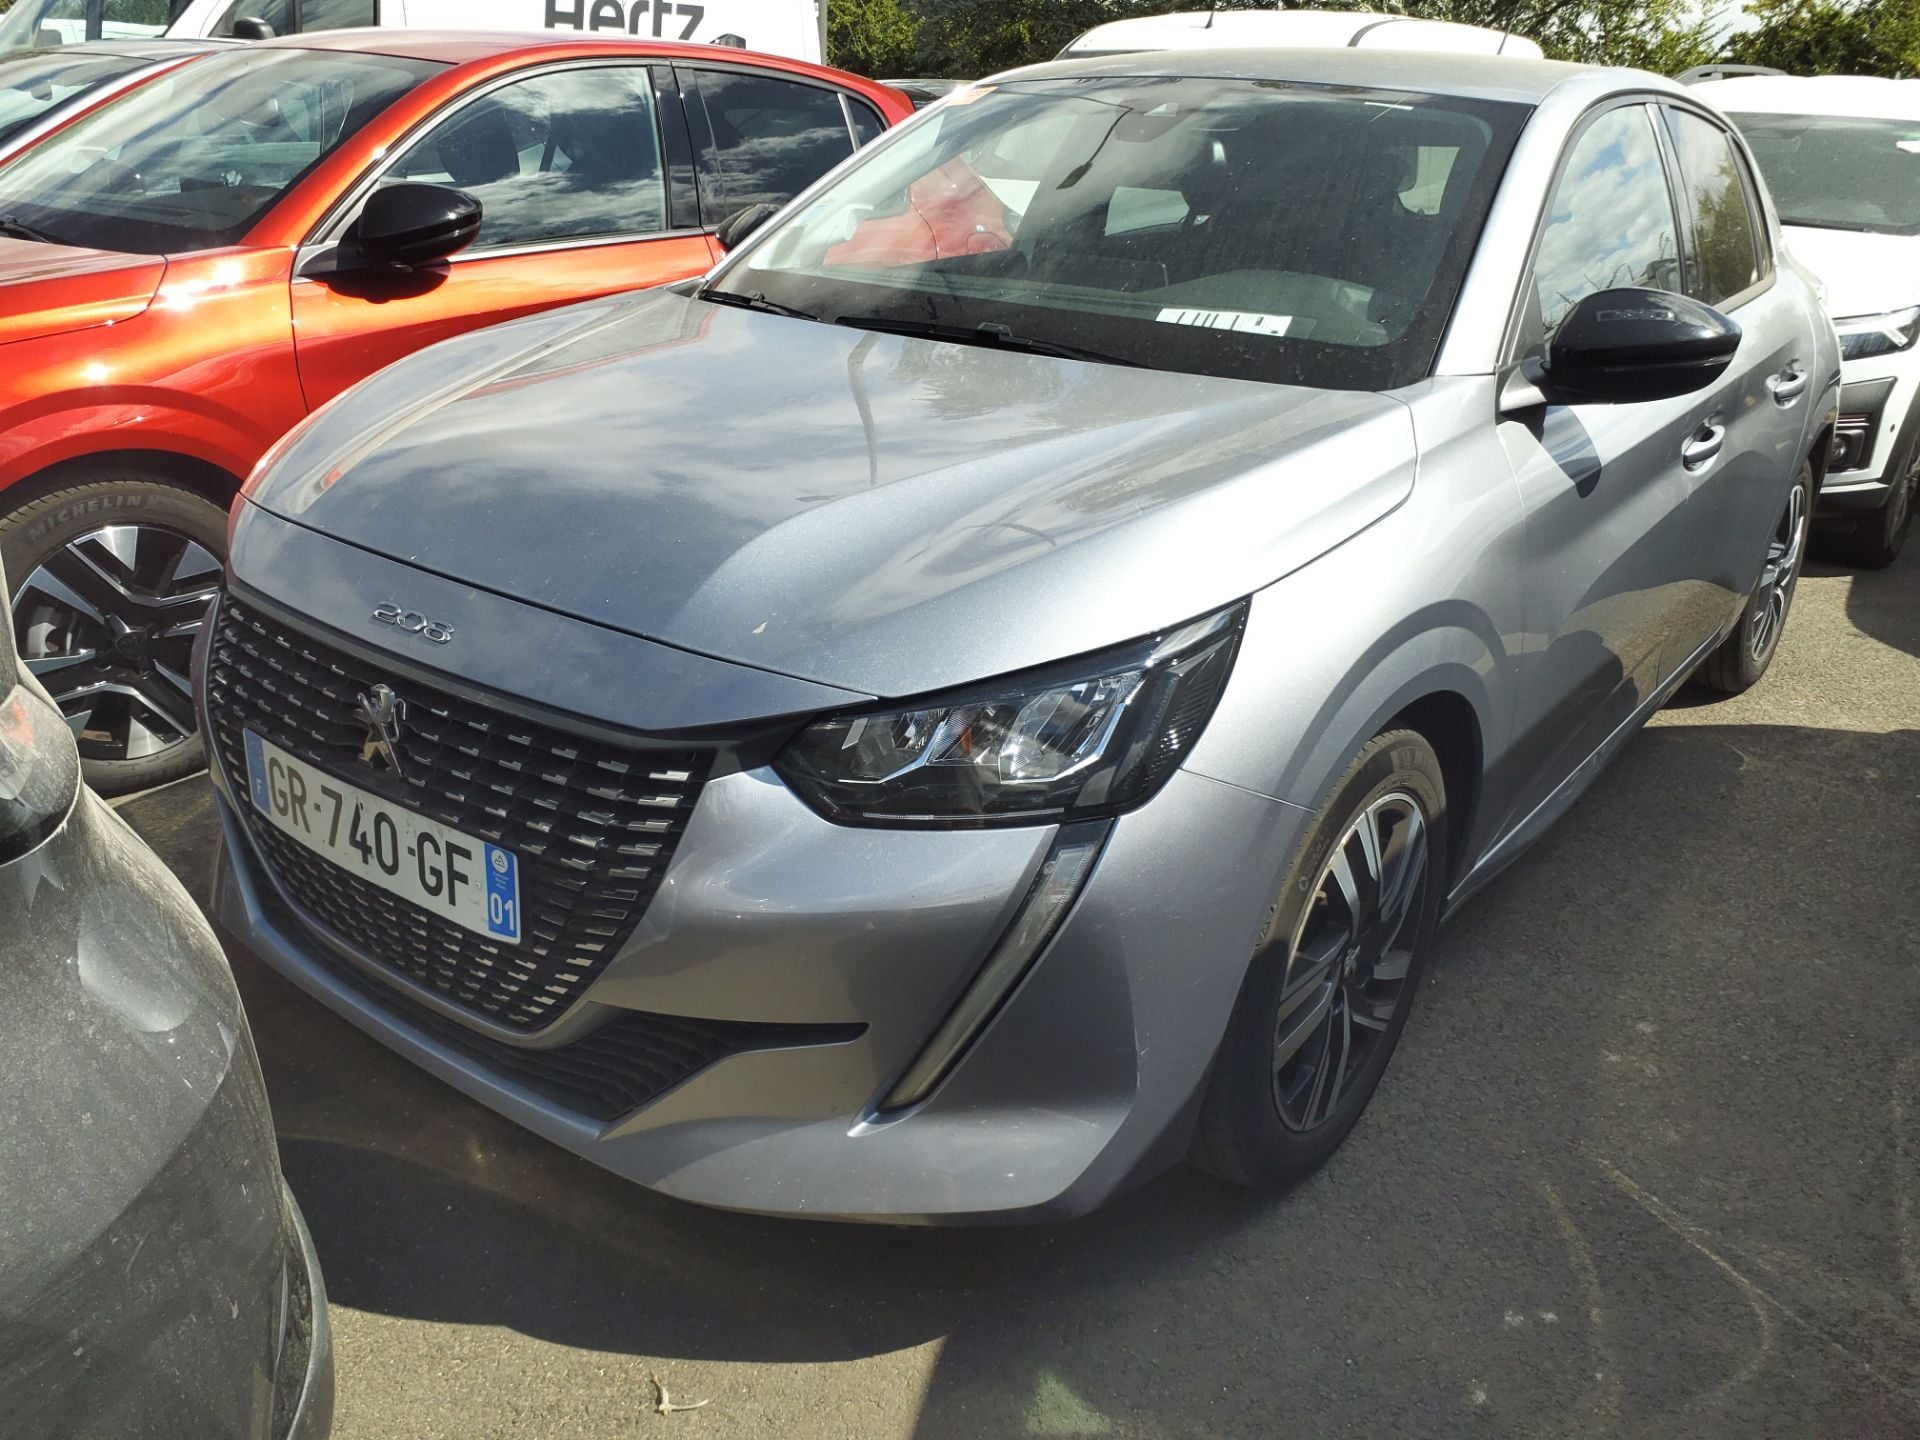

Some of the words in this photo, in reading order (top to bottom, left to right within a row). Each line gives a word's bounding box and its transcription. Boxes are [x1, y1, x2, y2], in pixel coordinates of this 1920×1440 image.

[29, 496, 142, 541] MICHELIN
[373, 601, 455, 644] 208
[269, 757, 472, 907] GR-740-GF
[490, 892, 515, 931] 01
